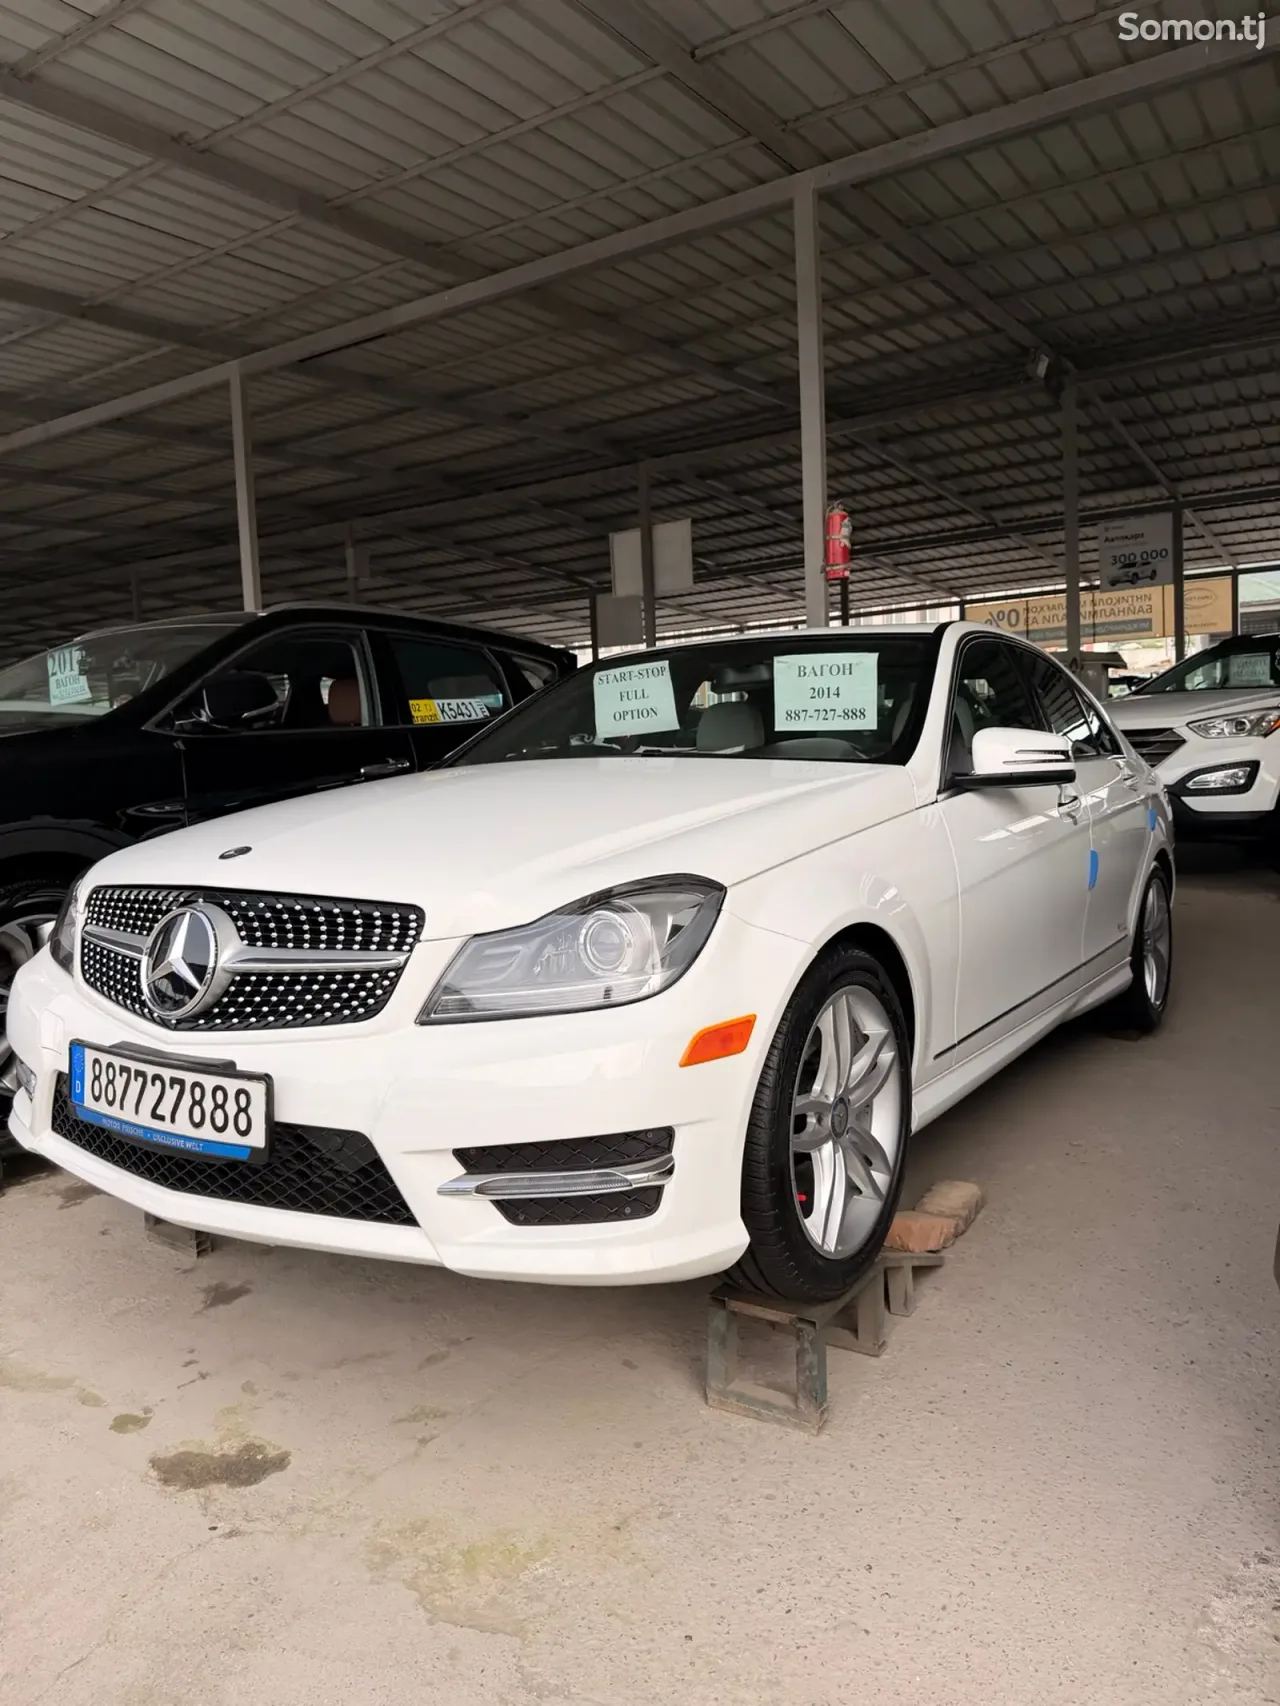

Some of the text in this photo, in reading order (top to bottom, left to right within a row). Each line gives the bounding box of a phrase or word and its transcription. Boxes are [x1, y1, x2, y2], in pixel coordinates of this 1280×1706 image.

[1111, 548, 1169, 566] 300 000
[598, 666, 666, 685] START-STOP
[797, 662, 853, 678] ВАГОН
[619, 688, 649, 702] FULL
[809, 686, 840, 699] 2014
[411, 703, 422, 712] 02
[437, 702, 479, 720] K5431
[613, 707, 658, 722] OPTION
[785, 707, 866, 721] 887-727-888
[75, 1080, 81, 1093] D
[91, 1058, 252, 1137] 887727888
